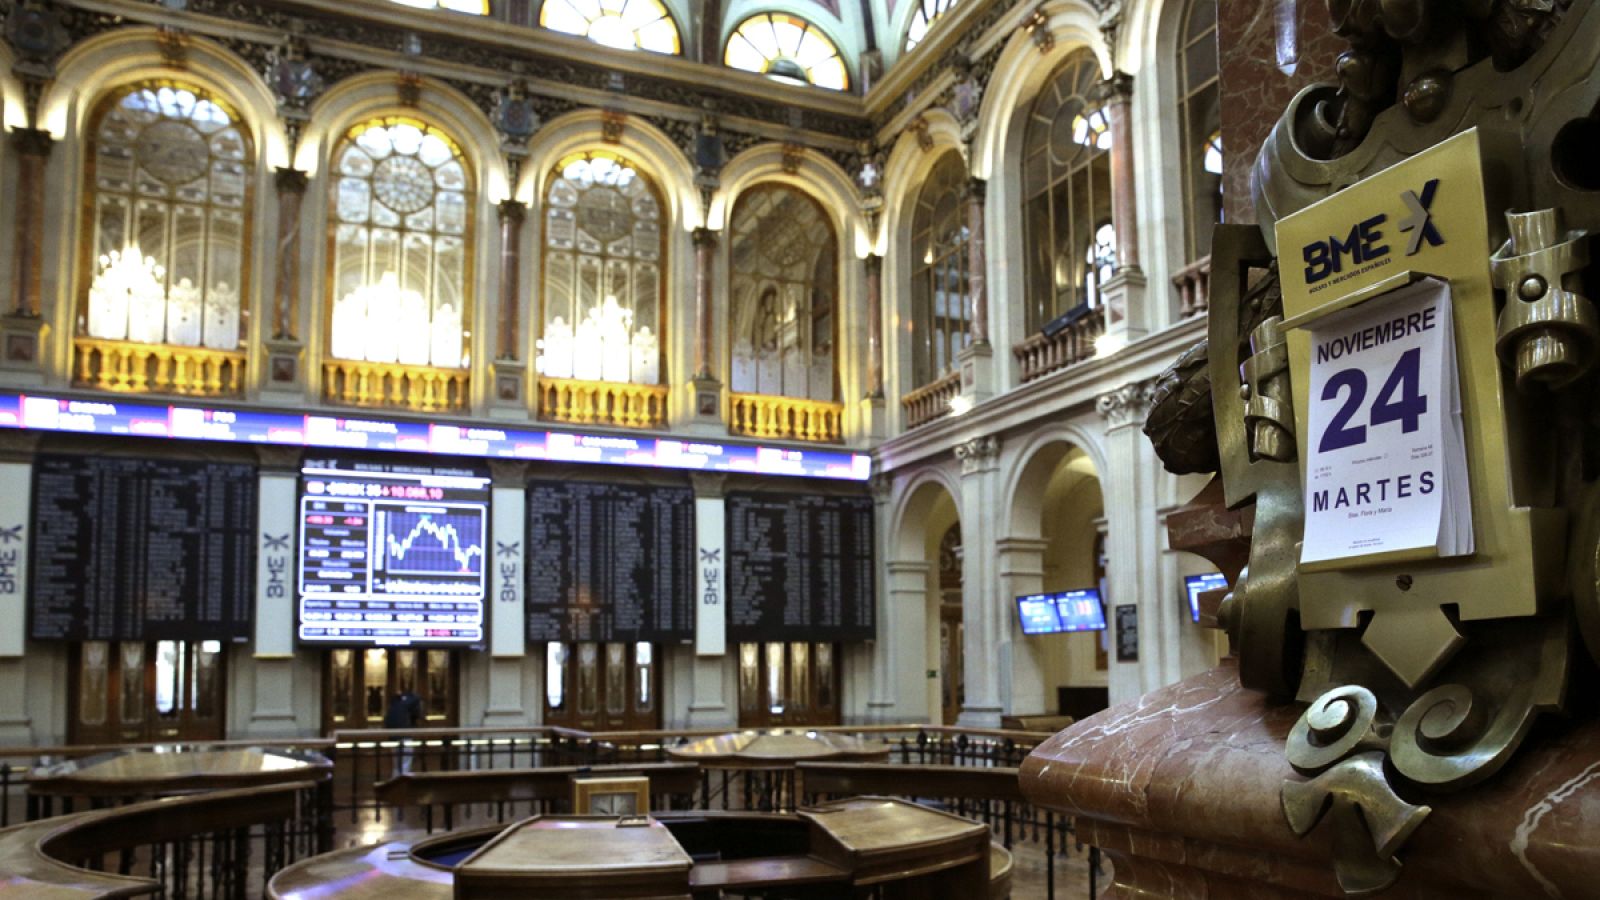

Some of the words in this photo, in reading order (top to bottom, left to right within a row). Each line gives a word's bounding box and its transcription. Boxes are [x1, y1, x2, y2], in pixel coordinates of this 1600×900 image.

[1317, 306, 1437, 365] NOVIEMBRE
[1318, 347, 1428, 454] 24
[1313, 470, 1435, 513] MARTES
